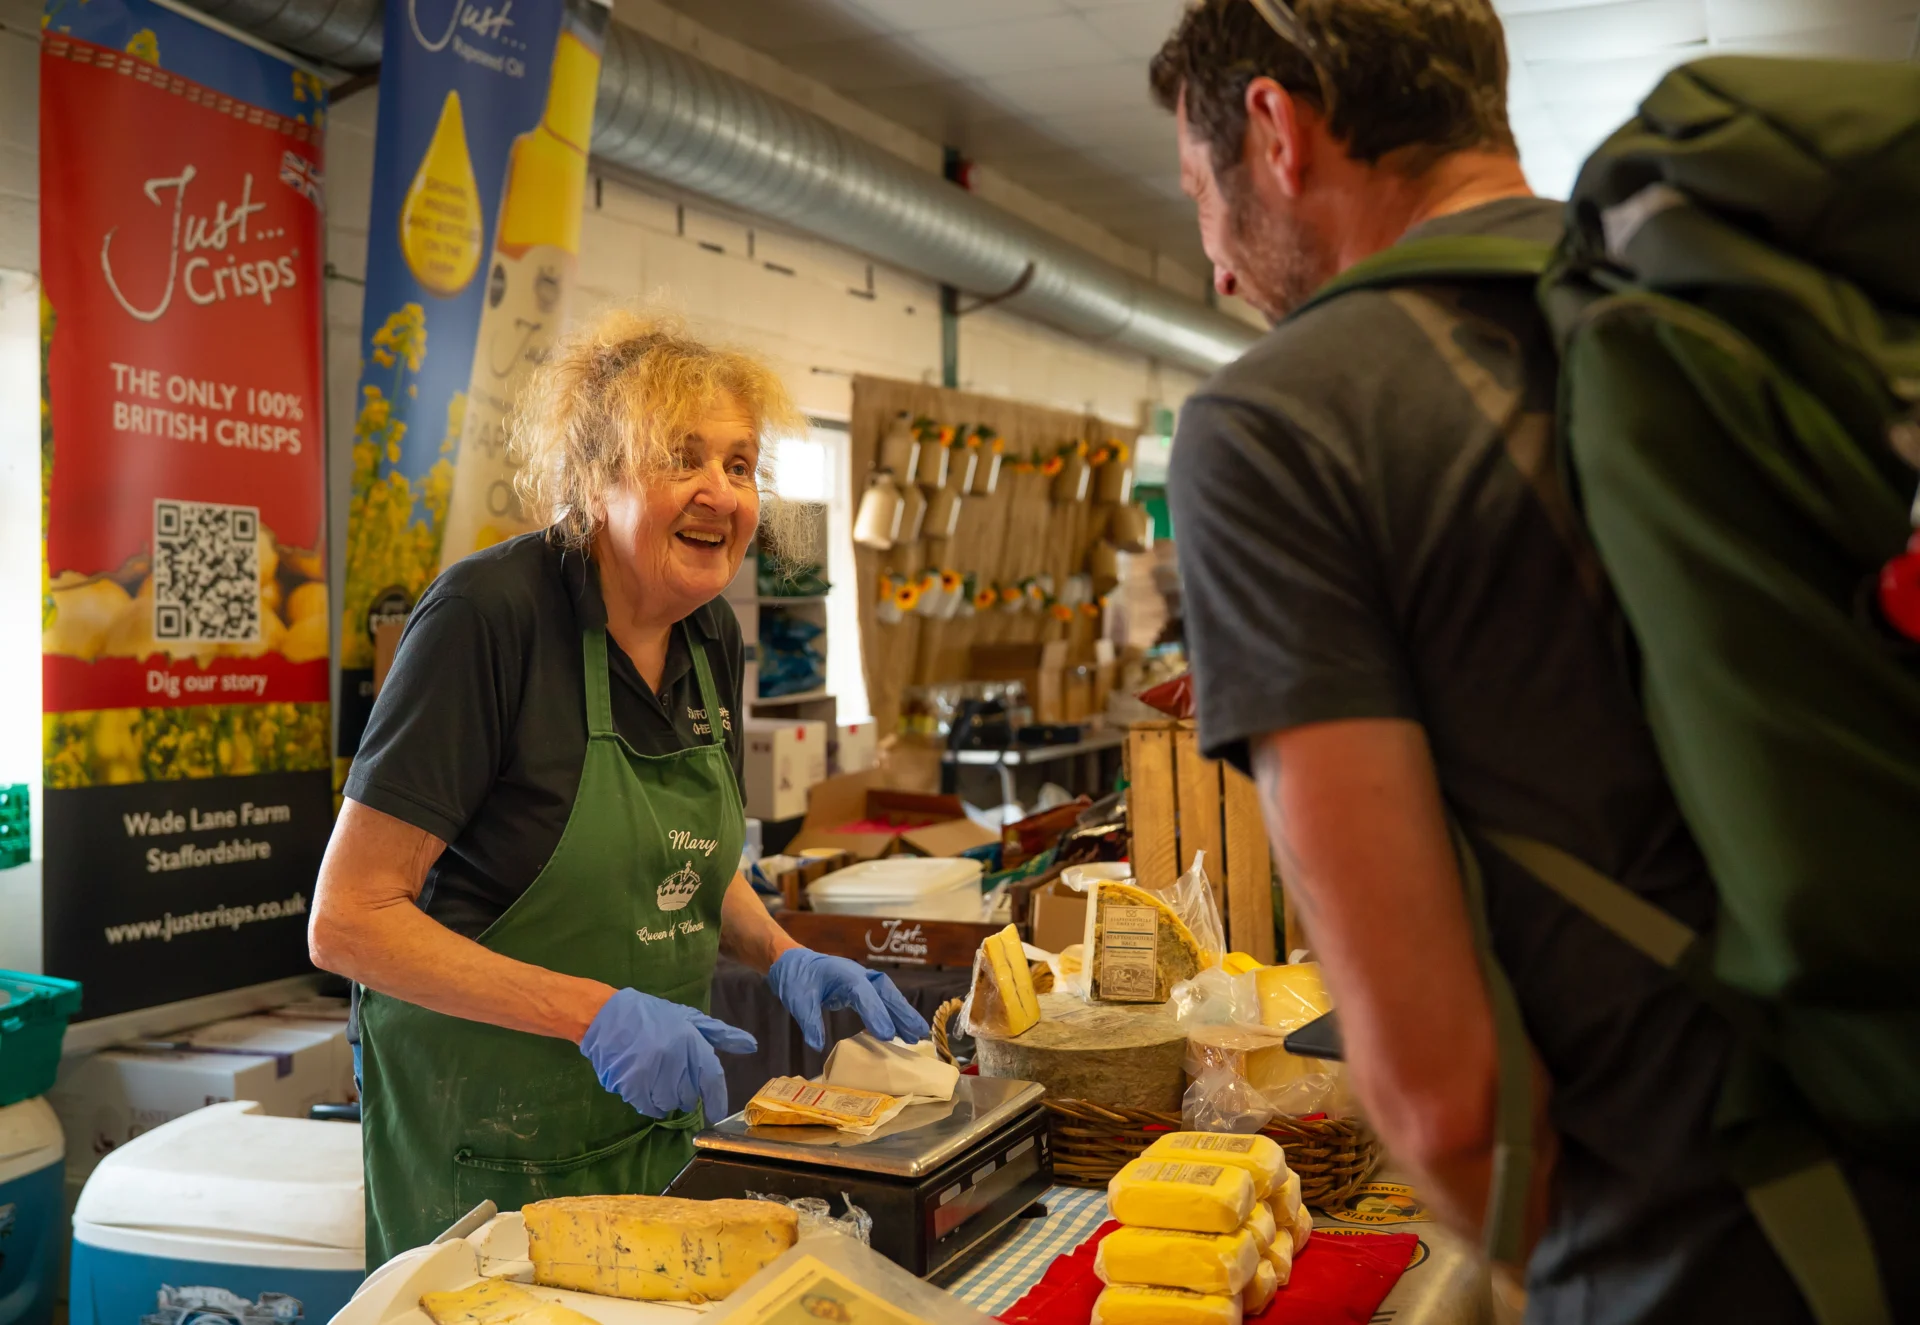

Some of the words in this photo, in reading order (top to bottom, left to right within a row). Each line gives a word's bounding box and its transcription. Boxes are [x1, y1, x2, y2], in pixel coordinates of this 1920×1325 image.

[184, 254, 296, 306] Crisps
[110, 362, 161, 398] THE
[166, 375, 238, 411] ONLY
[247, 387, 304, 421] 100%
[113, 401, 208, 443] BRITISH
[214, 418, 302, 455] CRISPS
[146, 670, 181, 699] Dig
[184, 675, 218, 692] our
[221, 673, 268, 696] story
[123, 809, 186, 837] Wade
[189, 807, 237, 831] Lane
[240, 802, 291, 826] Farm
[145, 838, 271, 873] Staffordshire
[668, 829, 718, 857] Mary
[105, 892, 307, 945] www.justcrisps.co.uk
[636, 926, 667, 945] Queen
